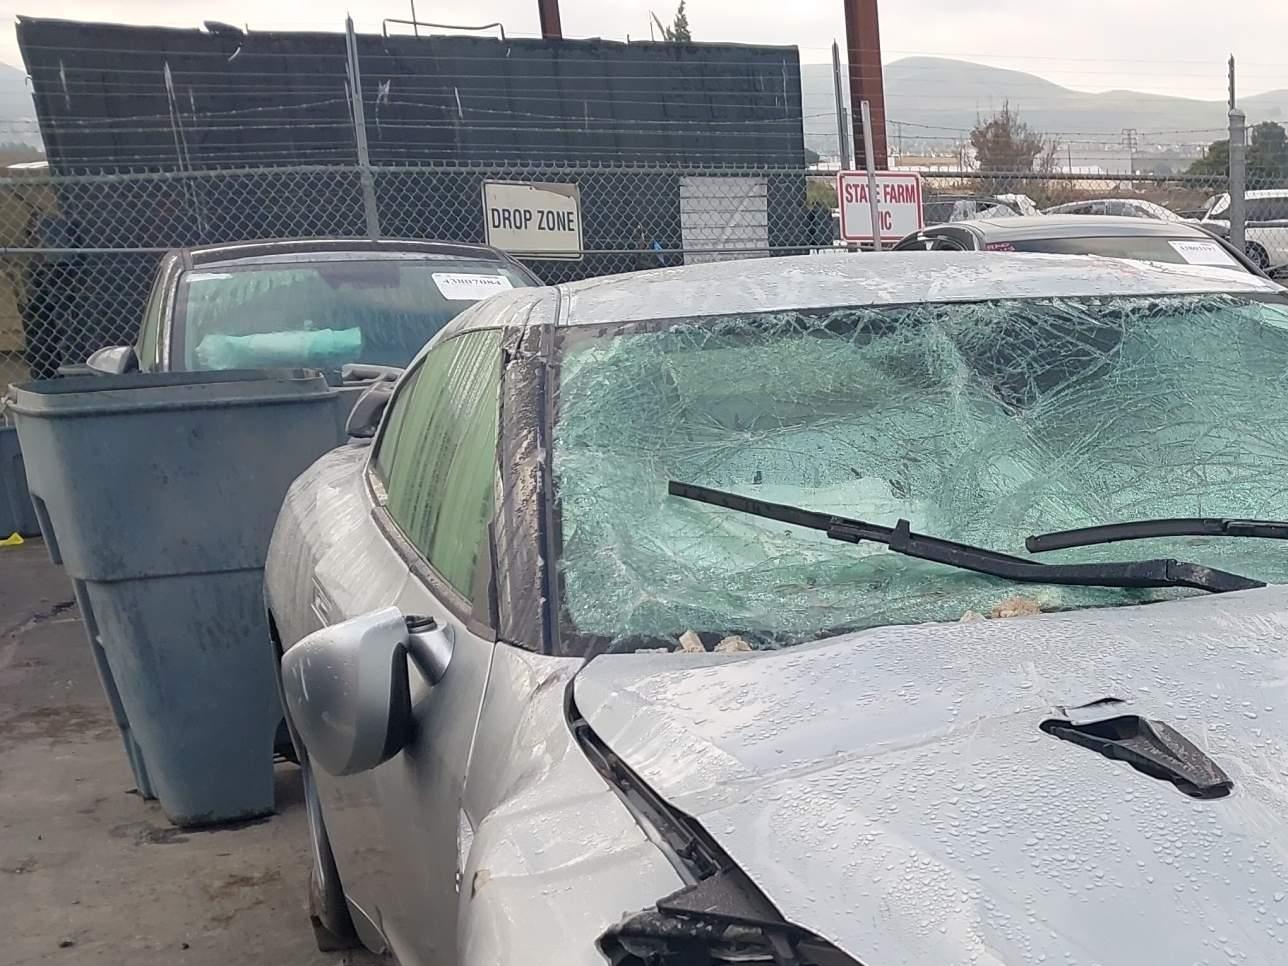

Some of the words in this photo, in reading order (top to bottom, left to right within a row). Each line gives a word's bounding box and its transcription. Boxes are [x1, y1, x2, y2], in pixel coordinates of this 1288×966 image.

[845, 184, 880, 203] STAE
[883, 184, 916, 203] FARM
[491, 208, 532, 230] DROP
[537, 210, 575, 231] ZONE
[877, 211, 892, 231] IC
